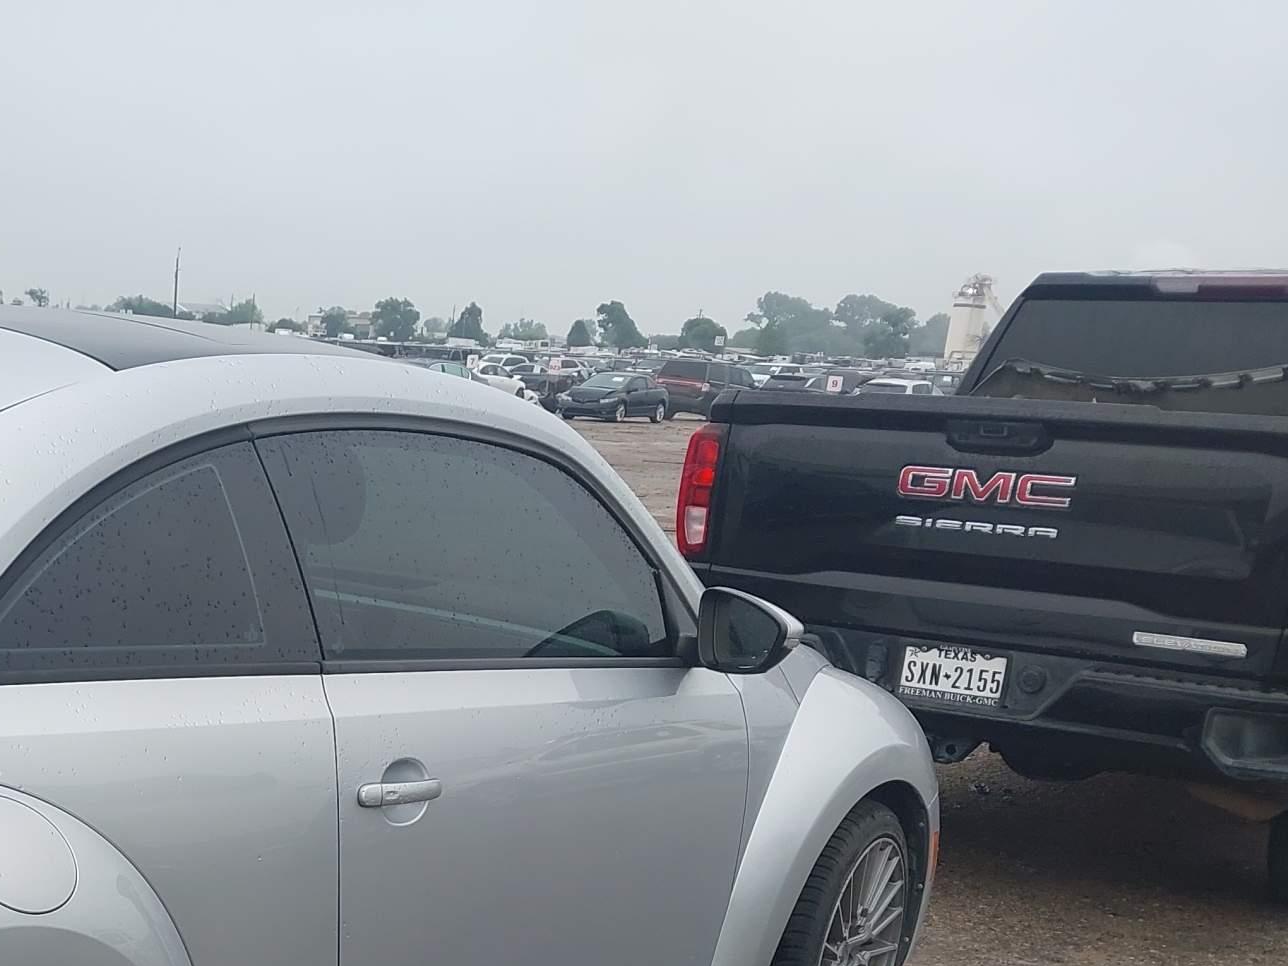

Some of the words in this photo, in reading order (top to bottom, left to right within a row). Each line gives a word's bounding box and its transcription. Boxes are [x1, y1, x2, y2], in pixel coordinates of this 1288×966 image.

[898, 465, 1077, 508] GMC
[894, 515, 1059, 539] SIERRA
[936, 648, 978, 662] TEXAS
[899, 686, 943, 699] FREEMAN
